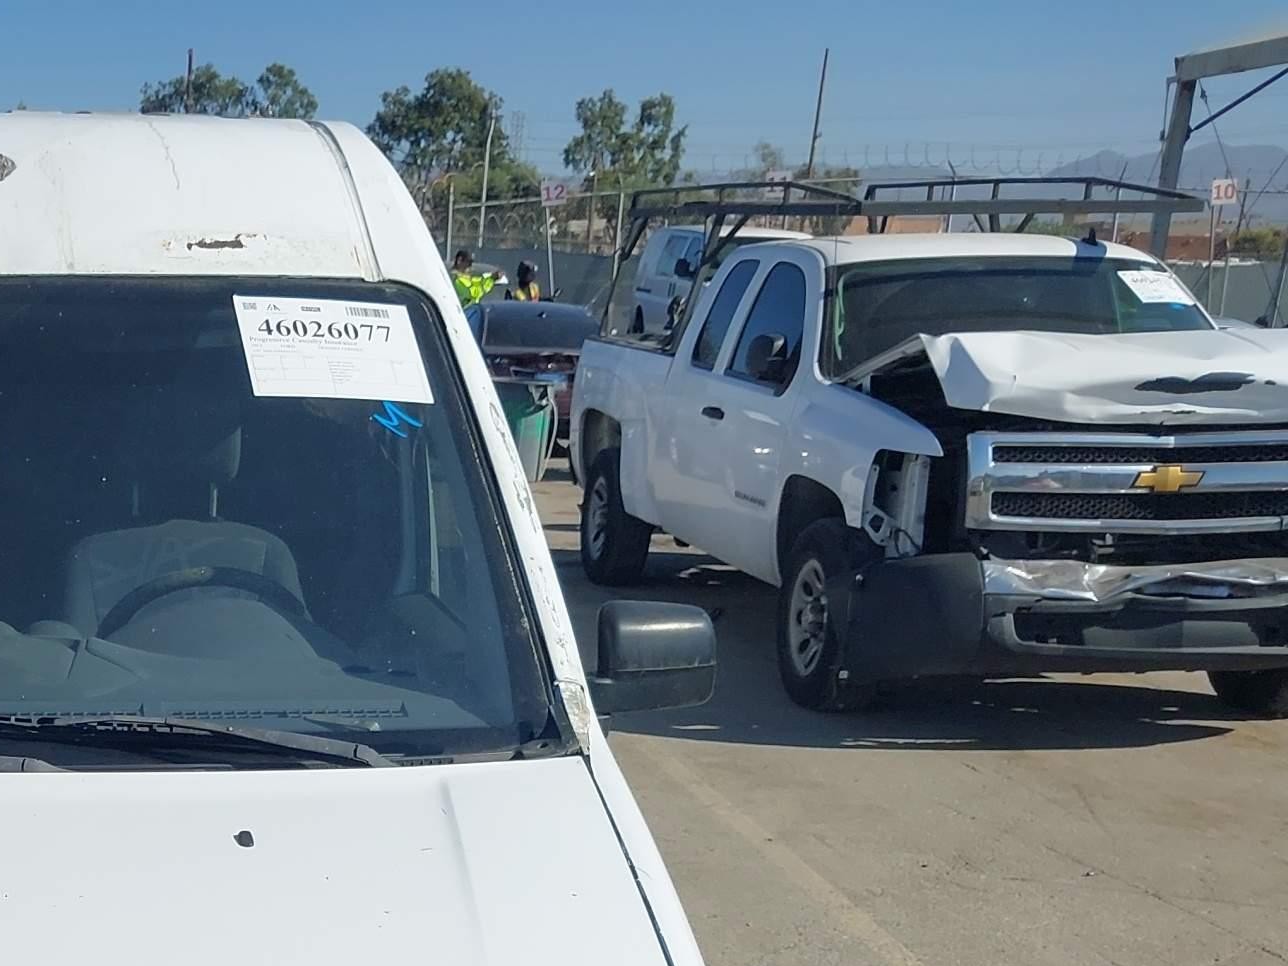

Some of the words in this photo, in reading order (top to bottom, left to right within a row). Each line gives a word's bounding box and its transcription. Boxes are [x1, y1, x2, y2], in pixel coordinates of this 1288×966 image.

[543, 184, 565, 201] 12
[1214, 183, 1235, 200] 10
[257, 318, 391, 343] 46026077
